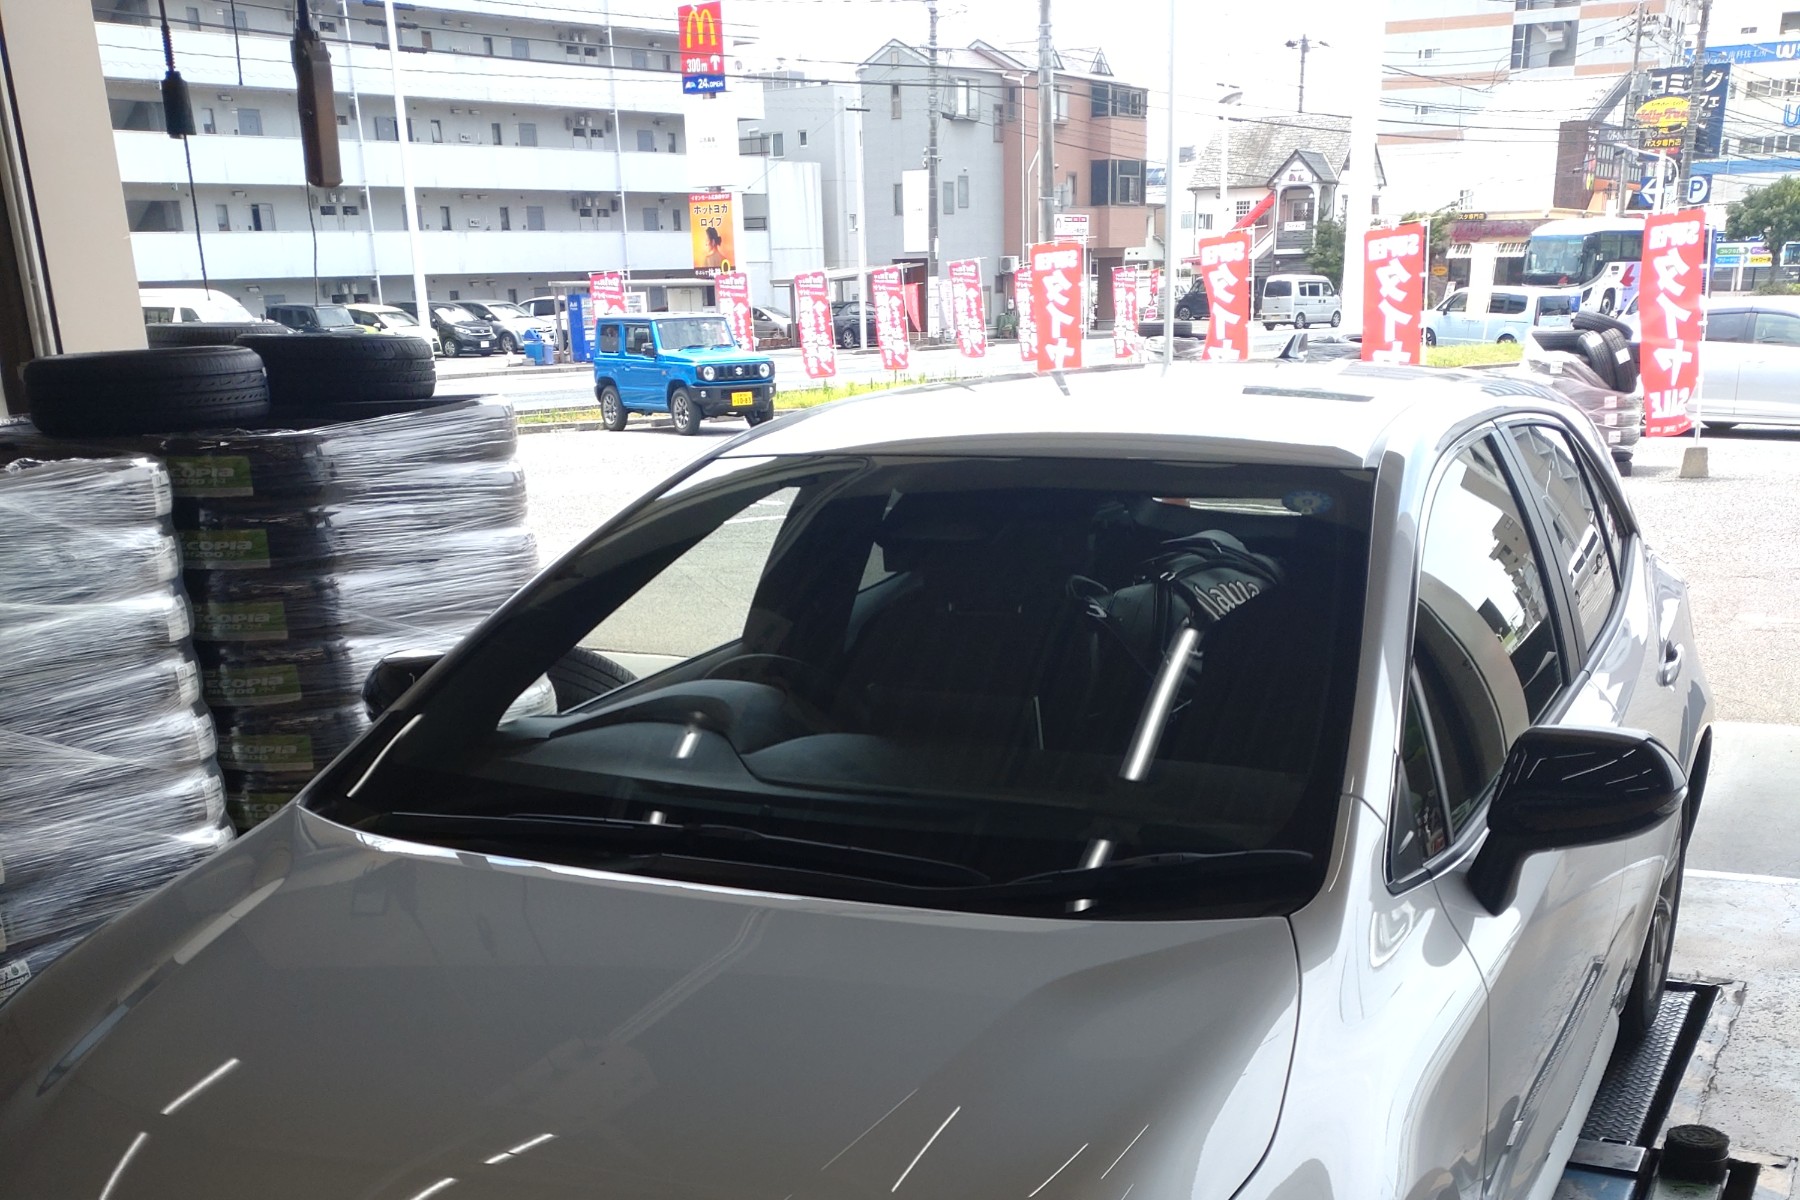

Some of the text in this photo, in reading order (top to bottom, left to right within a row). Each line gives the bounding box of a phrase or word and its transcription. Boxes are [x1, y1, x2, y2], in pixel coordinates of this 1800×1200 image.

[686, 58, 708, 72] 300m
[1651, 69, 1724, 94] コミク
[1689, 178, 1702, 199] P
[1458, 212, 1484, 220] スタ専門店
